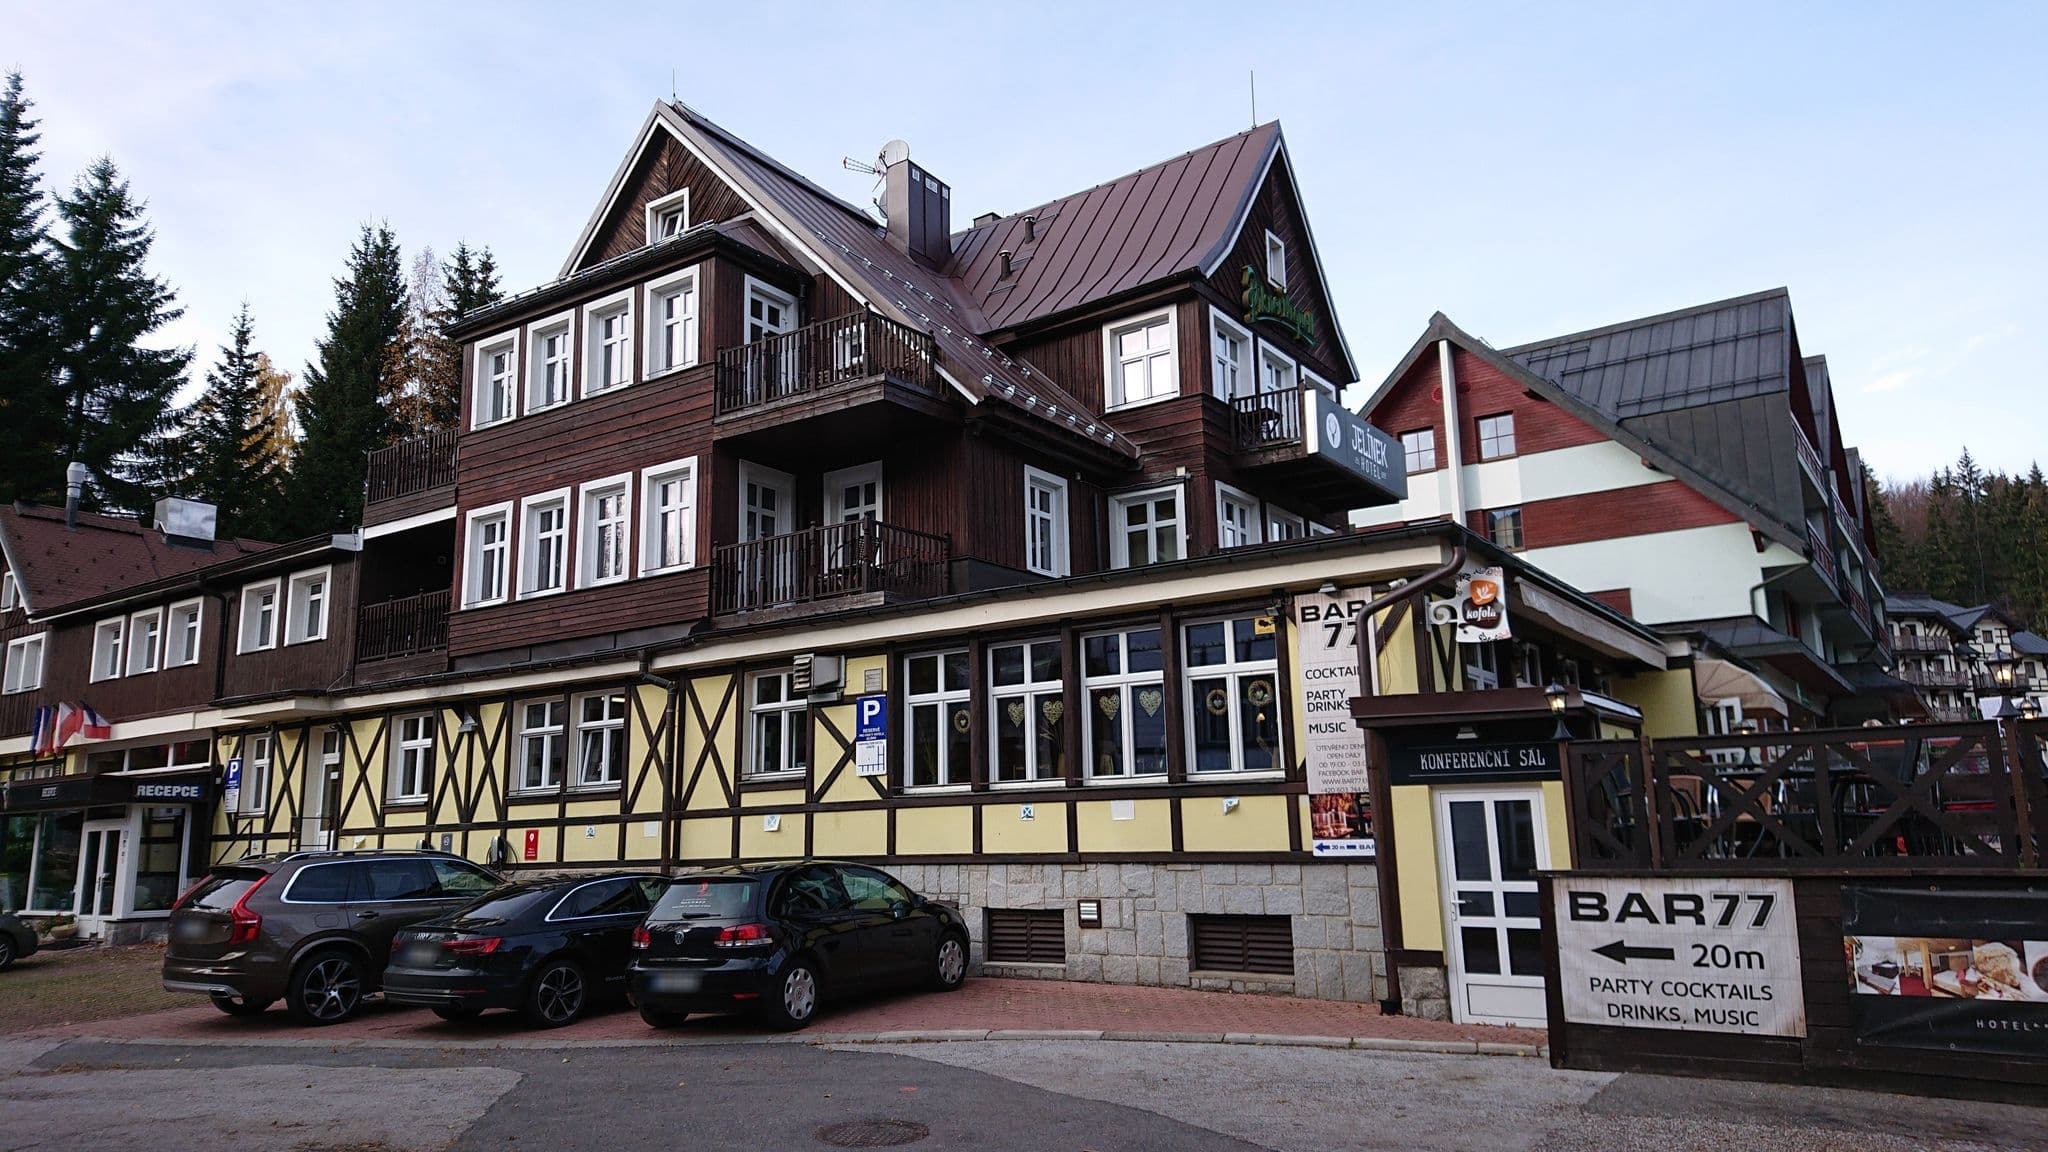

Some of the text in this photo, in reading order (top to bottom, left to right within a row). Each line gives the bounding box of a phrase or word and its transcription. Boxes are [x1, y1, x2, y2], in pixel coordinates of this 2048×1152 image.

[1361, 456, 1382, 480] HOTEL
[1466, 605, 1496, 621] kofola
[1306, 689, 1346, 702] PARTY
[864, 700, 880, 725] P
[1307, 700, 1351, 713] DRINKS
[1309, 722, 1347, 734] MUSIC
[1326, 751, 1361, 760] OPEN DAILY
[1420, 747, 1546, 770] KONFERENČNÍ SÁL
[229, 761, 239, 779] P
[136, 785, 199, 797] RECEPCE
[1568, 891, 1777, 929] BAR77
[1691, 943, 1765, 969] 20m
[1589, 977, 1773, 1000] PARTY COCKTAILS
[1607, 1003, 1760, 1027] DRINKS, MUSIC
[1976, 1019, 2032, 1032] HOTEL
